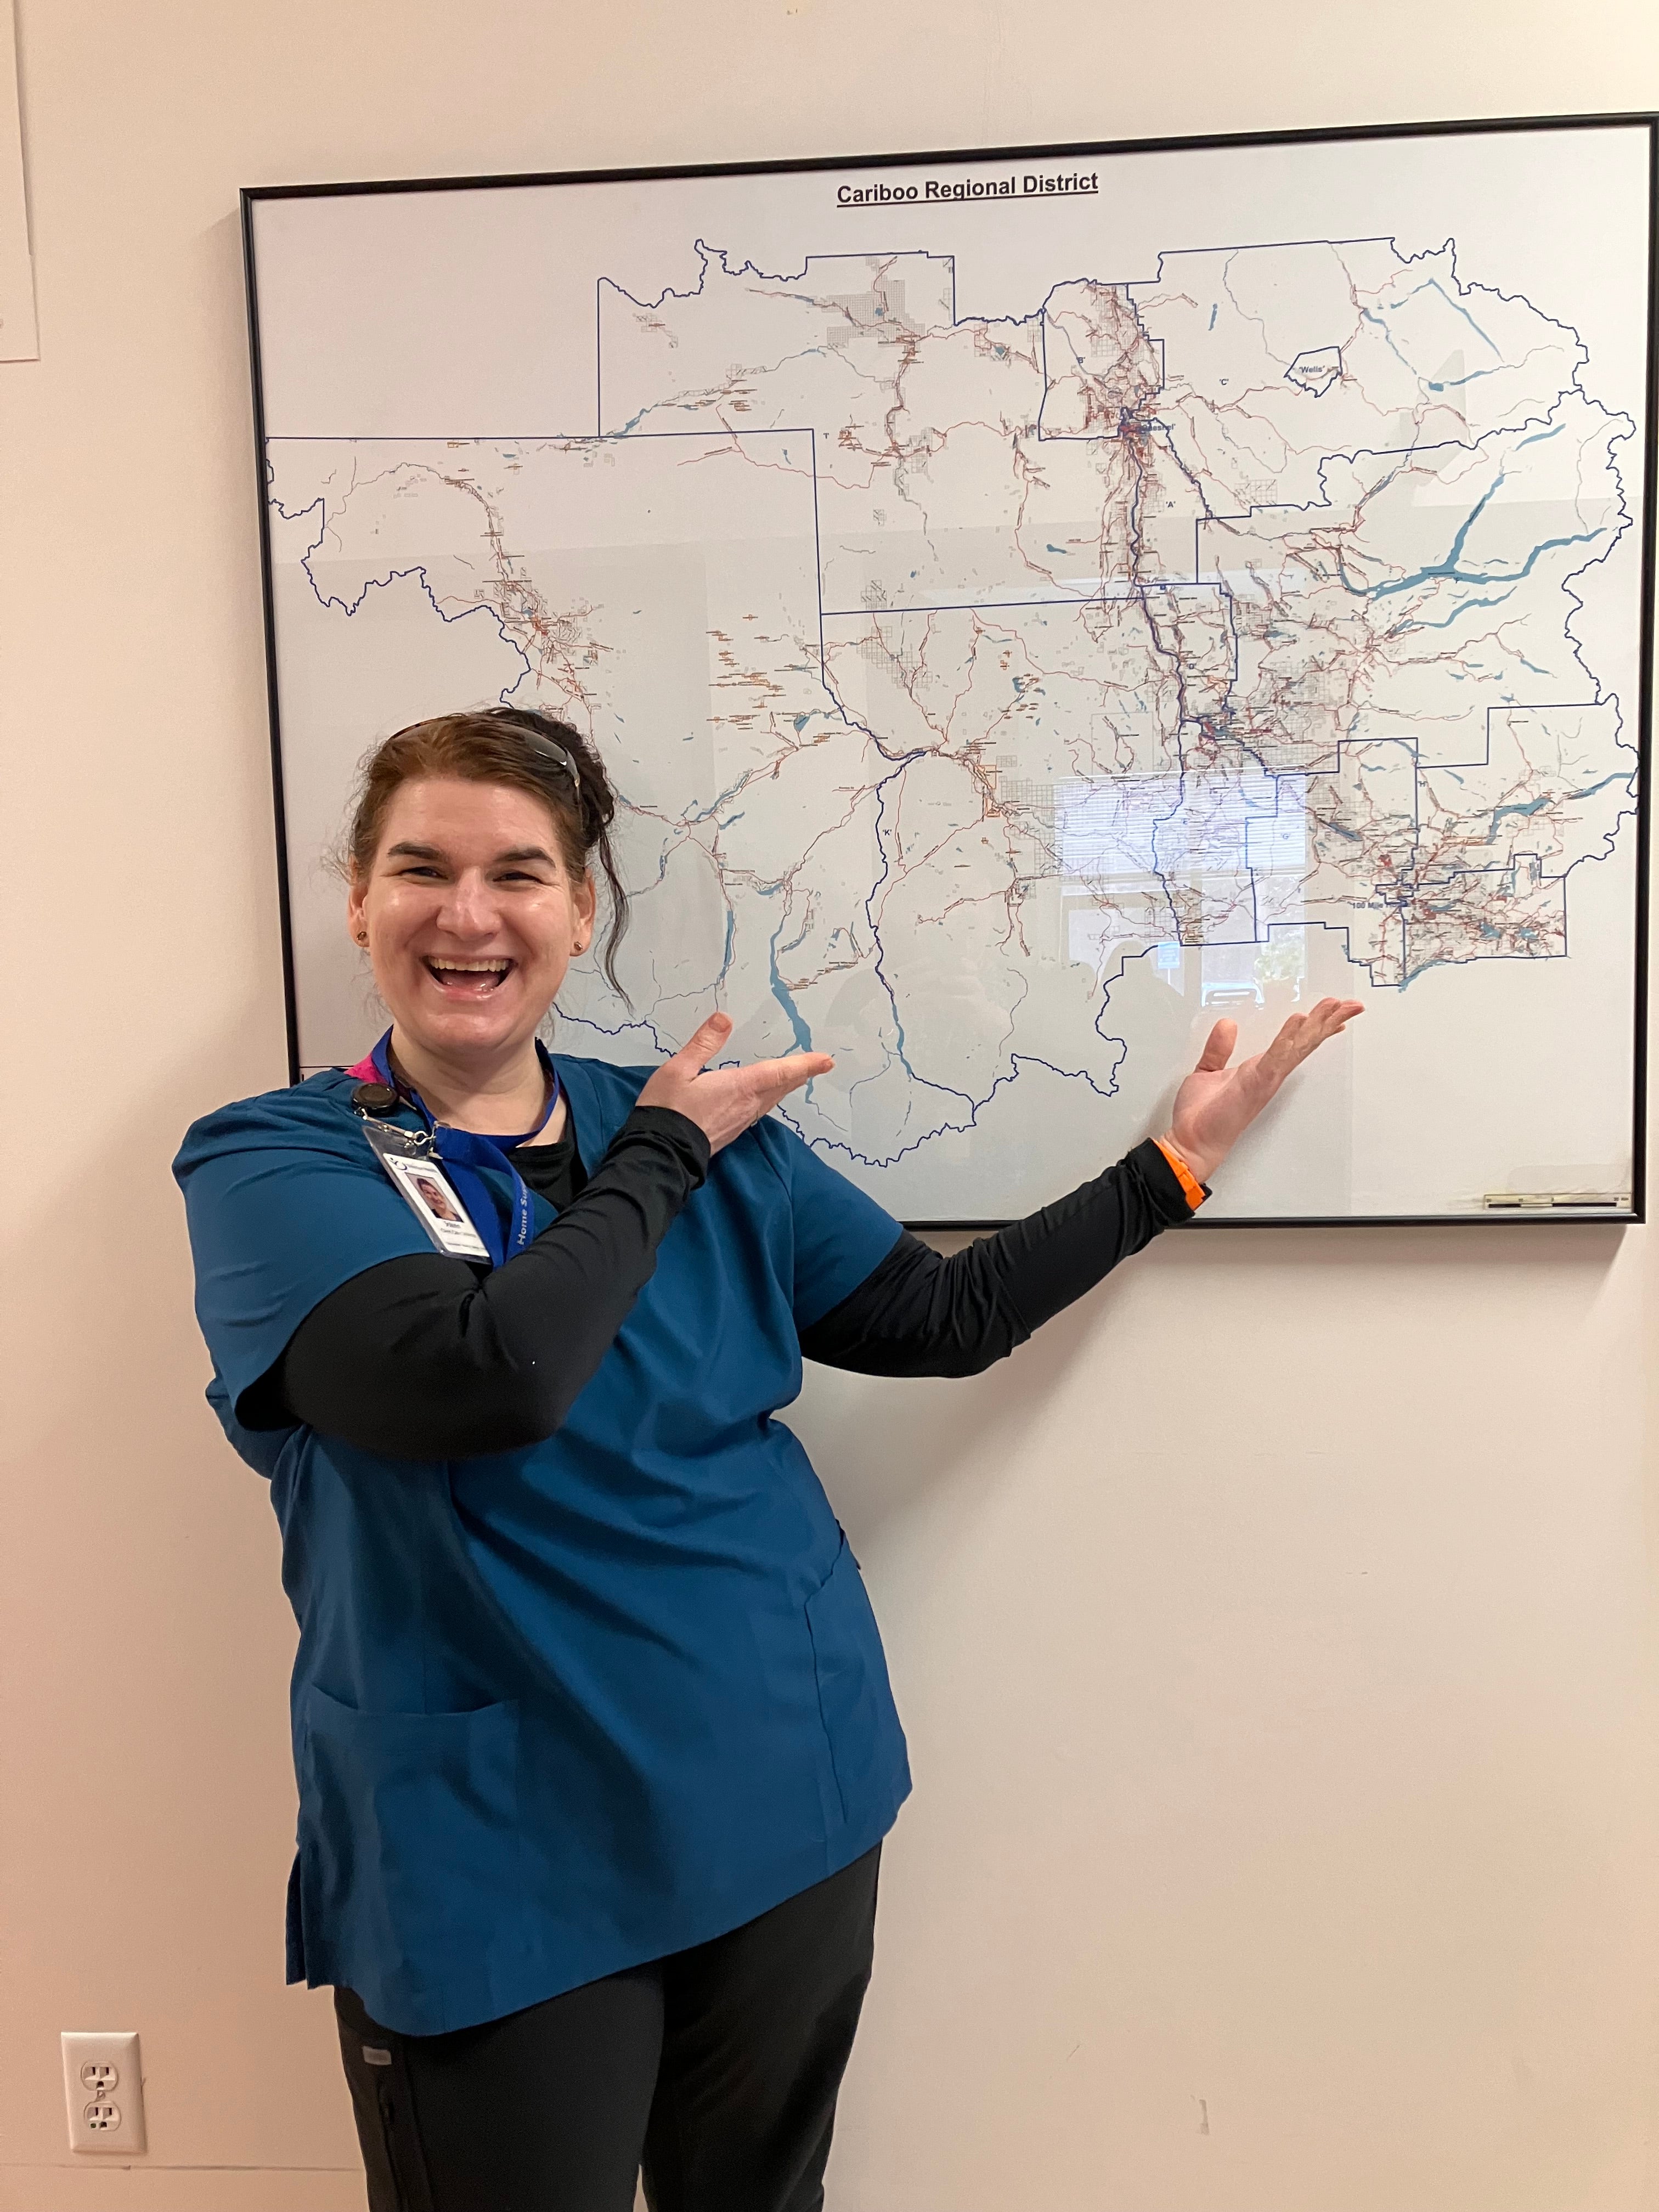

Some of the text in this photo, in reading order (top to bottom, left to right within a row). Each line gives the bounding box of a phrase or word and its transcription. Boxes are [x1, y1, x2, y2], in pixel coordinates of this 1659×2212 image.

[837, 172, 1098, 203] Cariboo Regional District
[517, 1209, 527, 1245] Home
